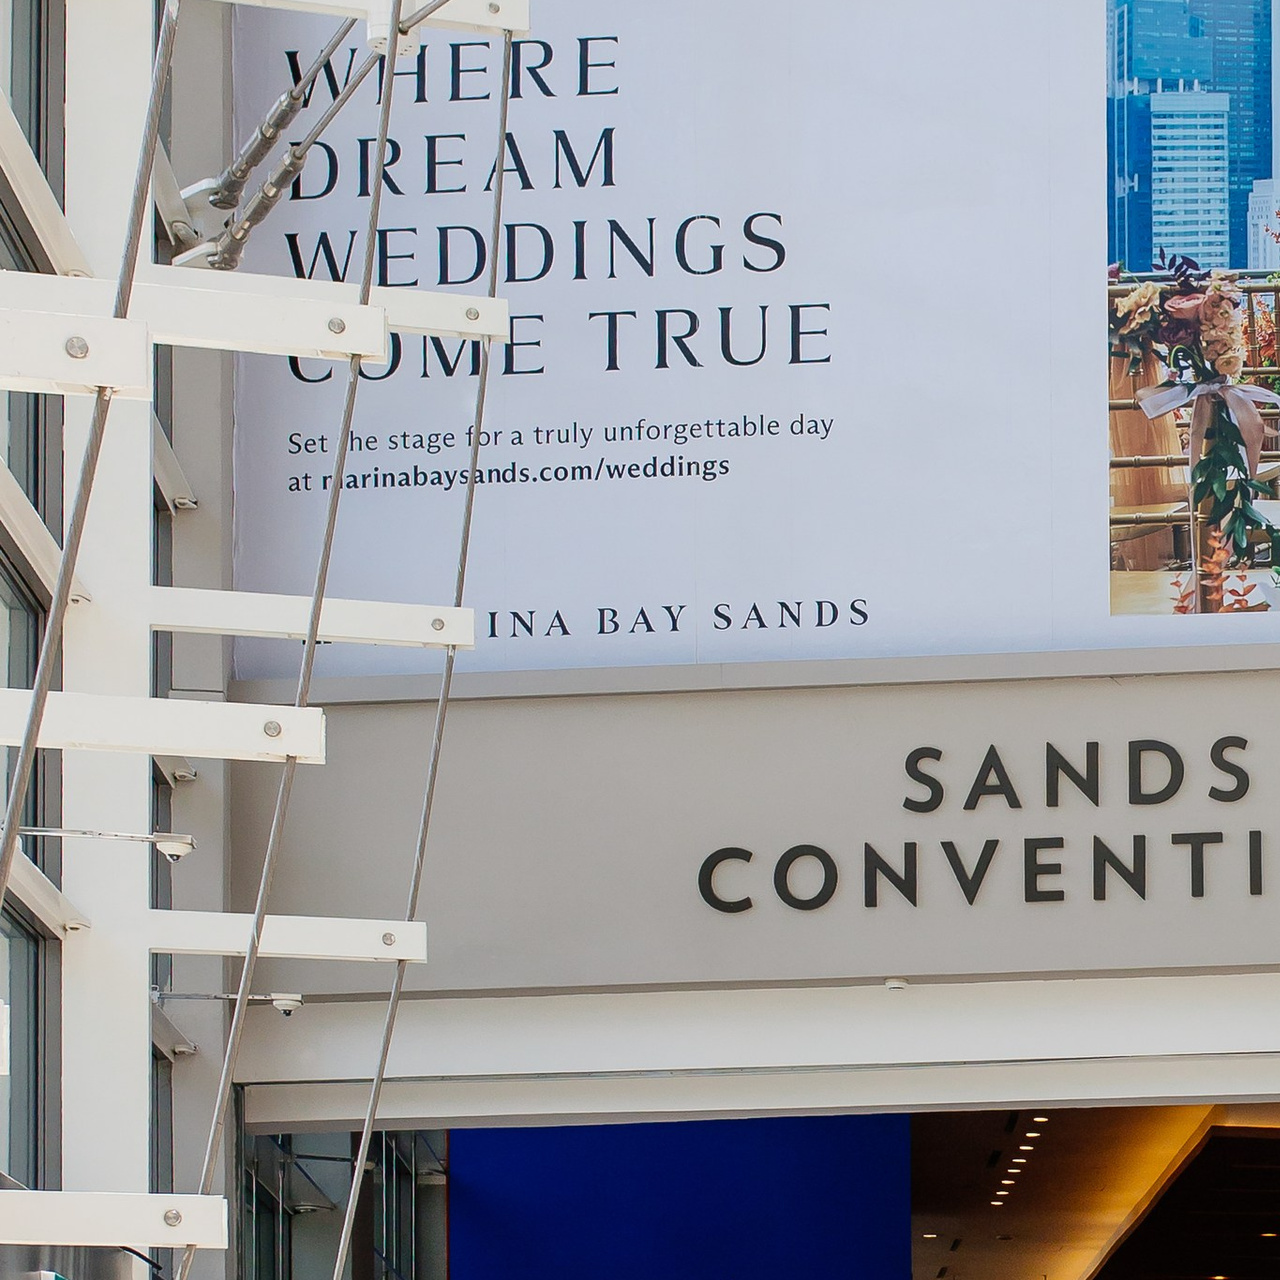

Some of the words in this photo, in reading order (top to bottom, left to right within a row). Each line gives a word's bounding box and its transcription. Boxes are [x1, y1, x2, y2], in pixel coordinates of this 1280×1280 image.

[284, 36, 619, 109] WHERE
[288, 126, 617, 201] DREAM
[284, 212, 787, 288] WEDDINGS
[588, 302, 832, 372] TRUE
[288, 433, 329, 454] Set
[349, 430, 379, 452] he
[388, 431, 456, 455] stage
[465, 424, 503, 448] for
[510, 430, 524, 446] a
[533, 421, 594, 449] truly
[604, 414, 781, 445] unforgettable
[790, 413, 835, 440] day
[288, 472, 313, 492] at
[486, 609, 573, 638] INA
[597, 603, 688, 635] BAY
[713, 598, 871, 631] SANDS
[902, 735, 1251, 813] SANDS
